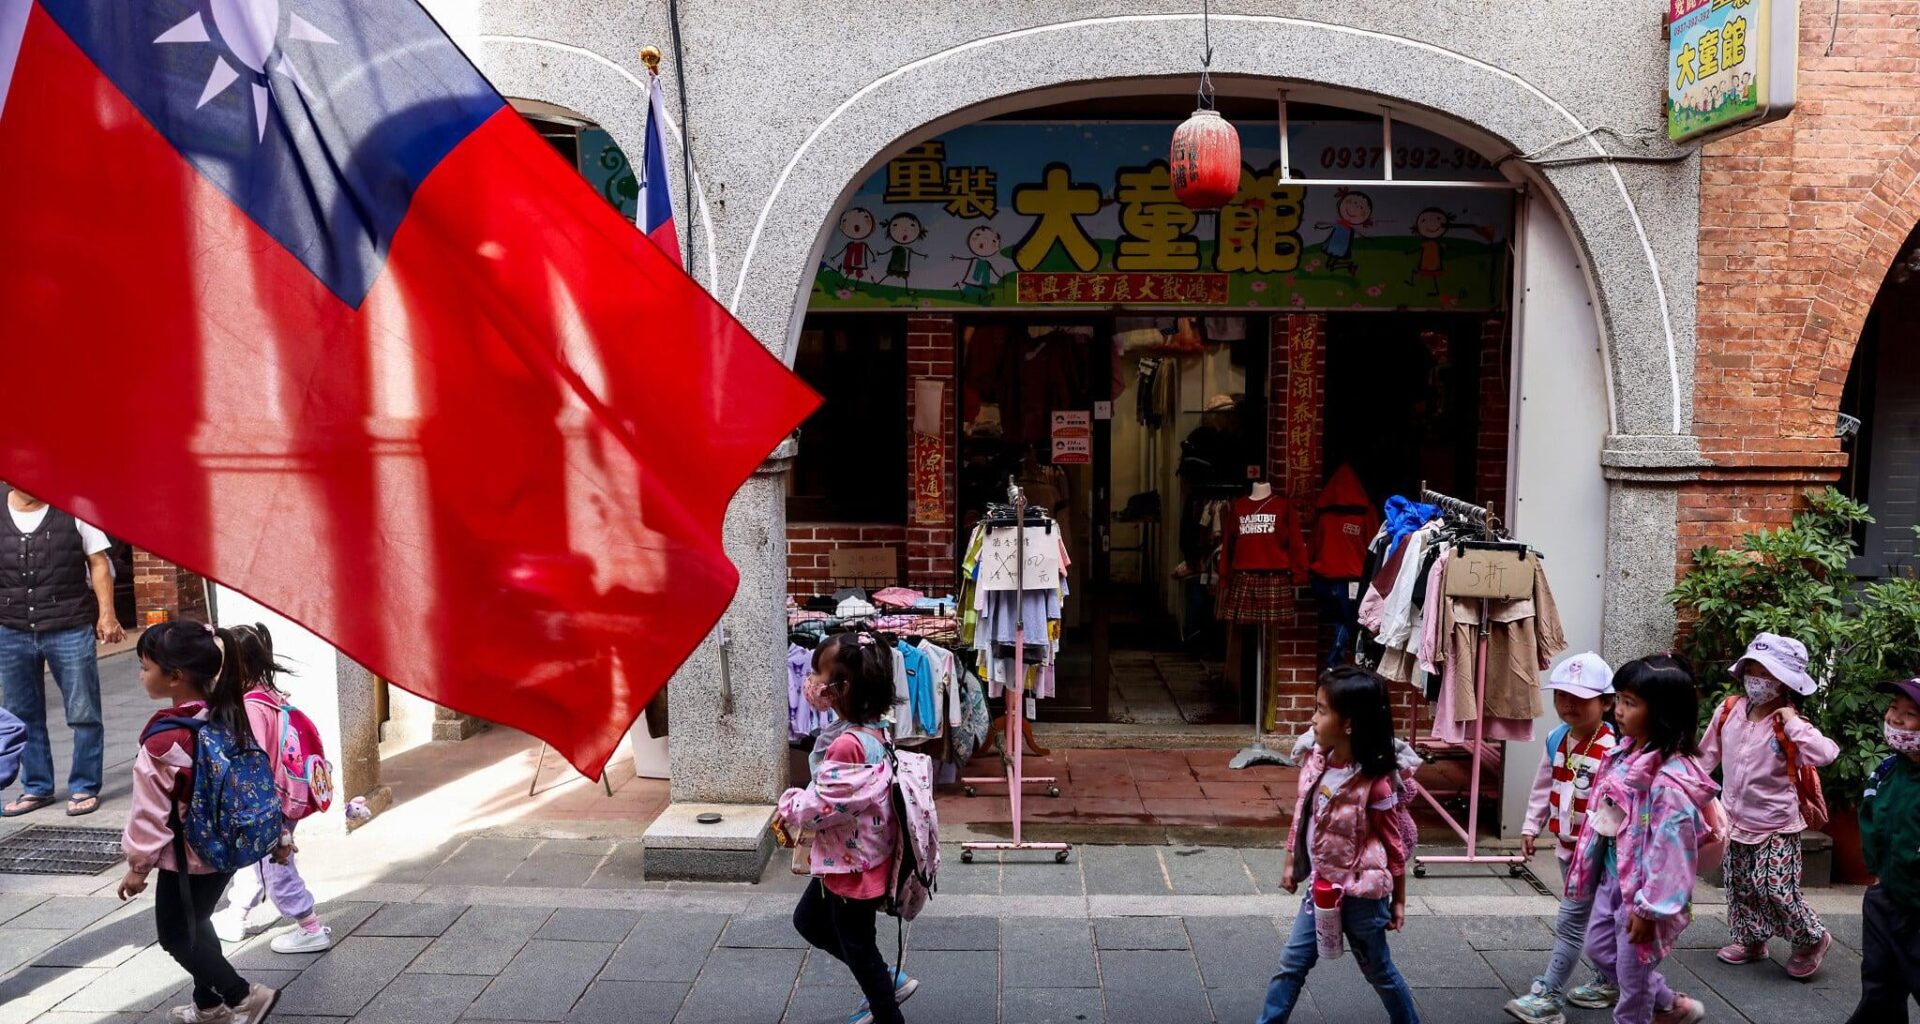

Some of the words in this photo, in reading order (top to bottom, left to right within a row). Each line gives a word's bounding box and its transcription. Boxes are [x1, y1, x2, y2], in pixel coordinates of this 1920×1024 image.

[1675, 15, 1747, 90] 大童館
[883, 140, 999, 220] 童裝
[1320, 146, 1494, 170] 0937392-39
[1014, 166, 1303, 273] 大童館
[1468, 561, 1508, 597] 5折
